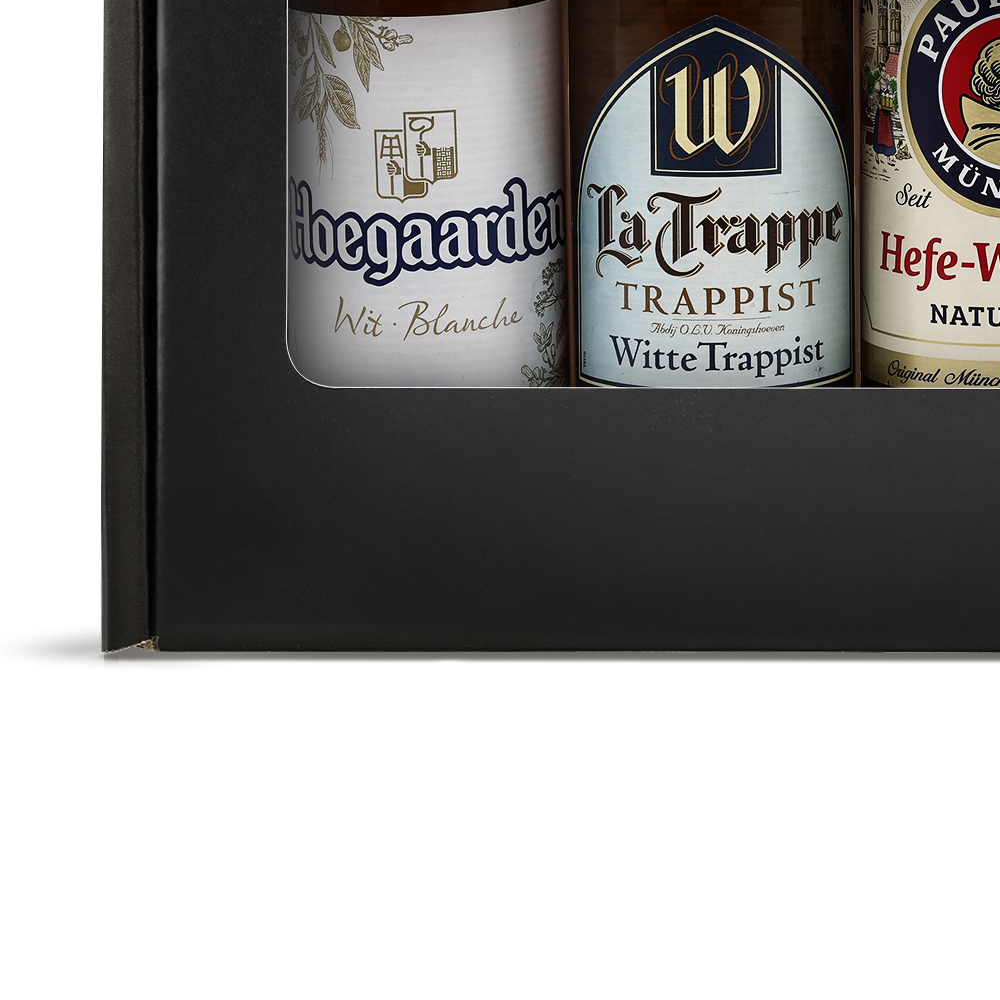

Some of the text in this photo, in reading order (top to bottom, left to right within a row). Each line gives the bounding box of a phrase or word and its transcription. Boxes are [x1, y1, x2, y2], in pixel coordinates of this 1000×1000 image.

[665, 64, 761, 155] W
[895, 183, 930, 209] Seit
[289, 176, 566, 287] Hoegaarden
[586, 183, 844, 279] La Trappe
[334, 296, 523, 342] Wit Blanche
[615, 278, 821, 316] TRAPPIST
[650, 322, 677, 337] Abdij
[714, 323, 786, 338] Koningshoeven
[608, 334, 698, 372] Witte
[696, 335, 825, 379] Trappist
[887, 359, 941, 384] Original
